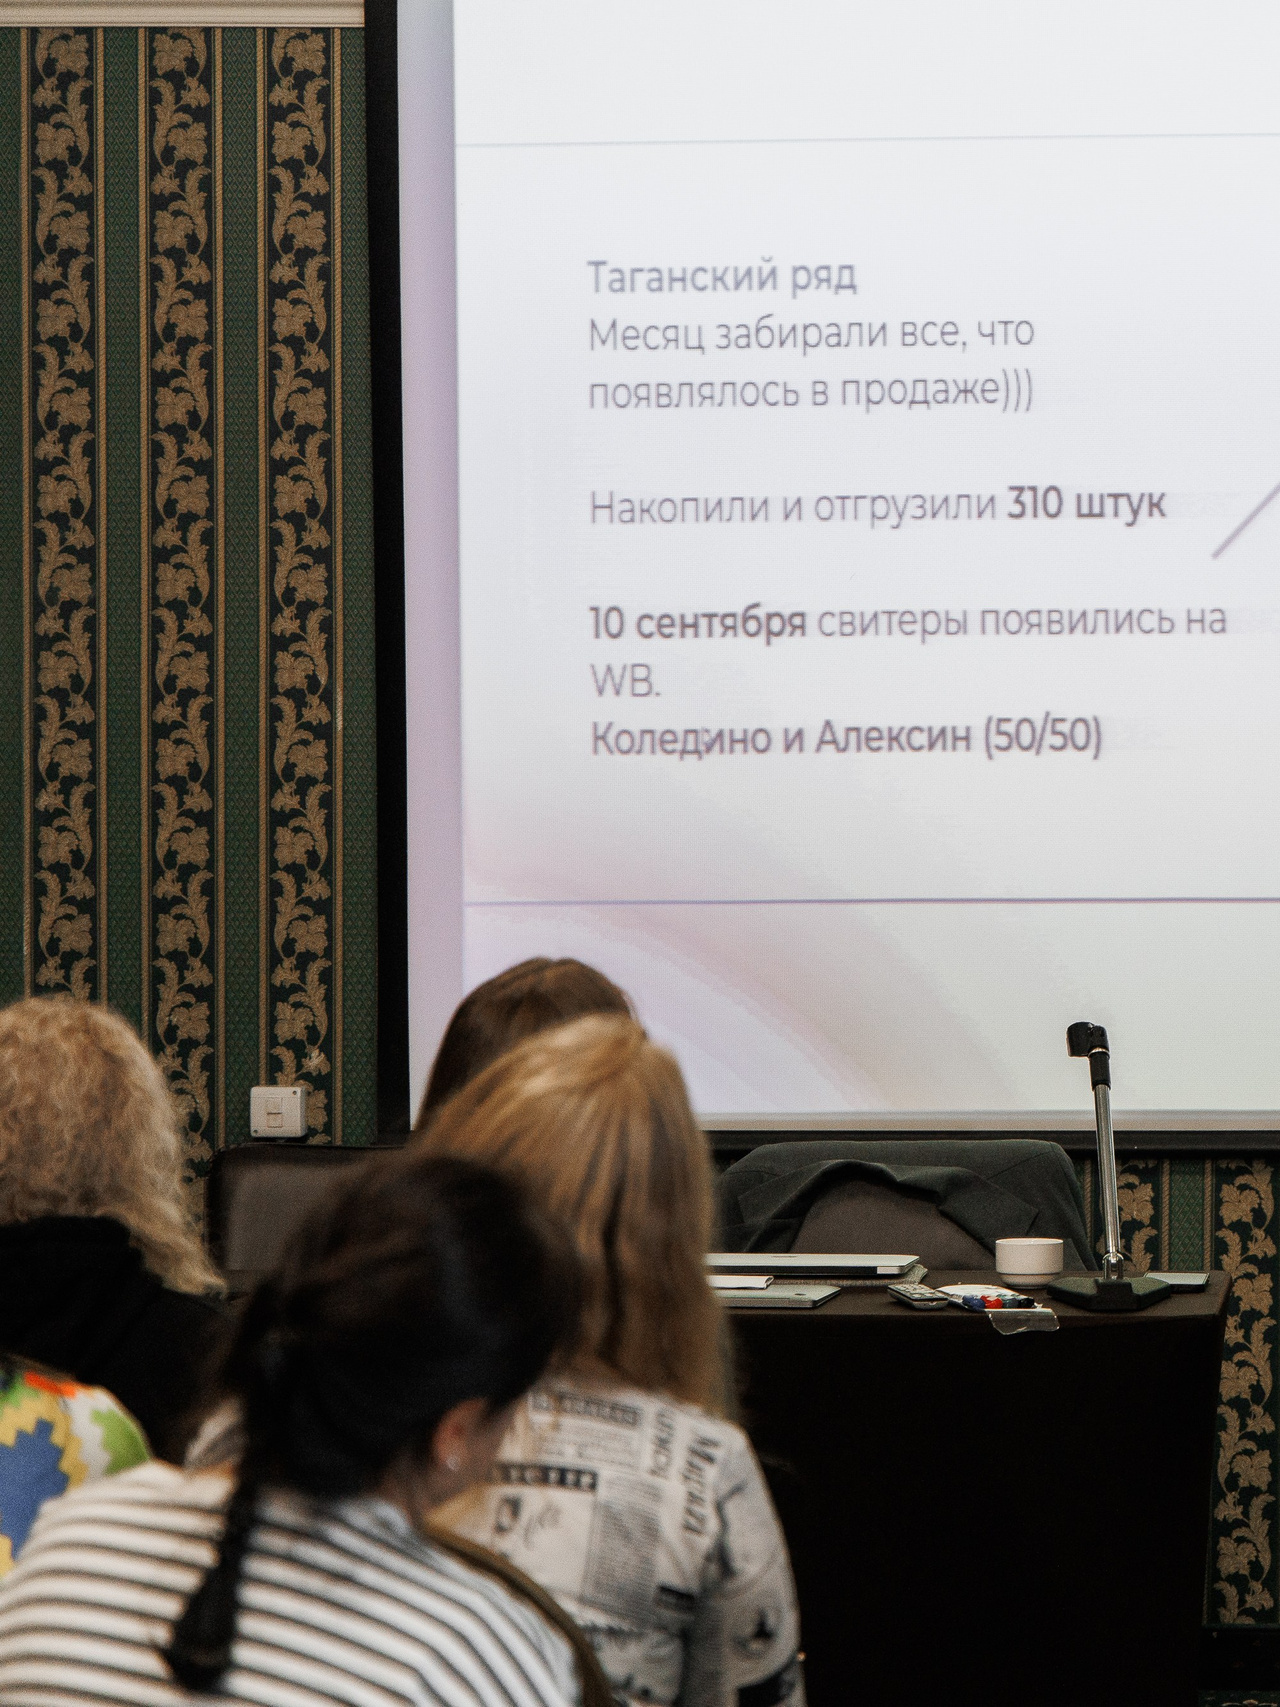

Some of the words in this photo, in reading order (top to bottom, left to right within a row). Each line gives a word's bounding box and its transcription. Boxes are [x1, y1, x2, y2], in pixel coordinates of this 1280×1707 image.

[587, 256, 779, 293] Таганский
[792, 262, 858, 299] ряд
[589, 318, 705, 354] Месяц
[716, 314, 888, 357] забирали
[900, 319, 968, 352] все,
[978, 318, 1035, 347] что
[589, 378, 799, 409] появлялось
[812, 377, 829, 406] в
[841, 368, 1034, 413] продаже)))
[590, 490, 770, 524] Накопили
[783, 494, 803, 523] и
[815, 491, 997, 529] отгрузили
[1007, 485, 1063, 519] 310
[1075, 488, 1167, 527] штук
[589, 606, 625, 640] 10
[635, 603, 808, 647] сентября
[817, 606, 969, 645] свитеры
[980, 604, 1176, 636] появились
[1186, 605, 1229, 634] на
[591, 663, 662, 698] WB.
[591, 720, 772, 761] Коледино
[784, 724, 804, 753] и
[816, 719, 971, 753] Алексин
[985, 711, 1102, 760] (50/50)
